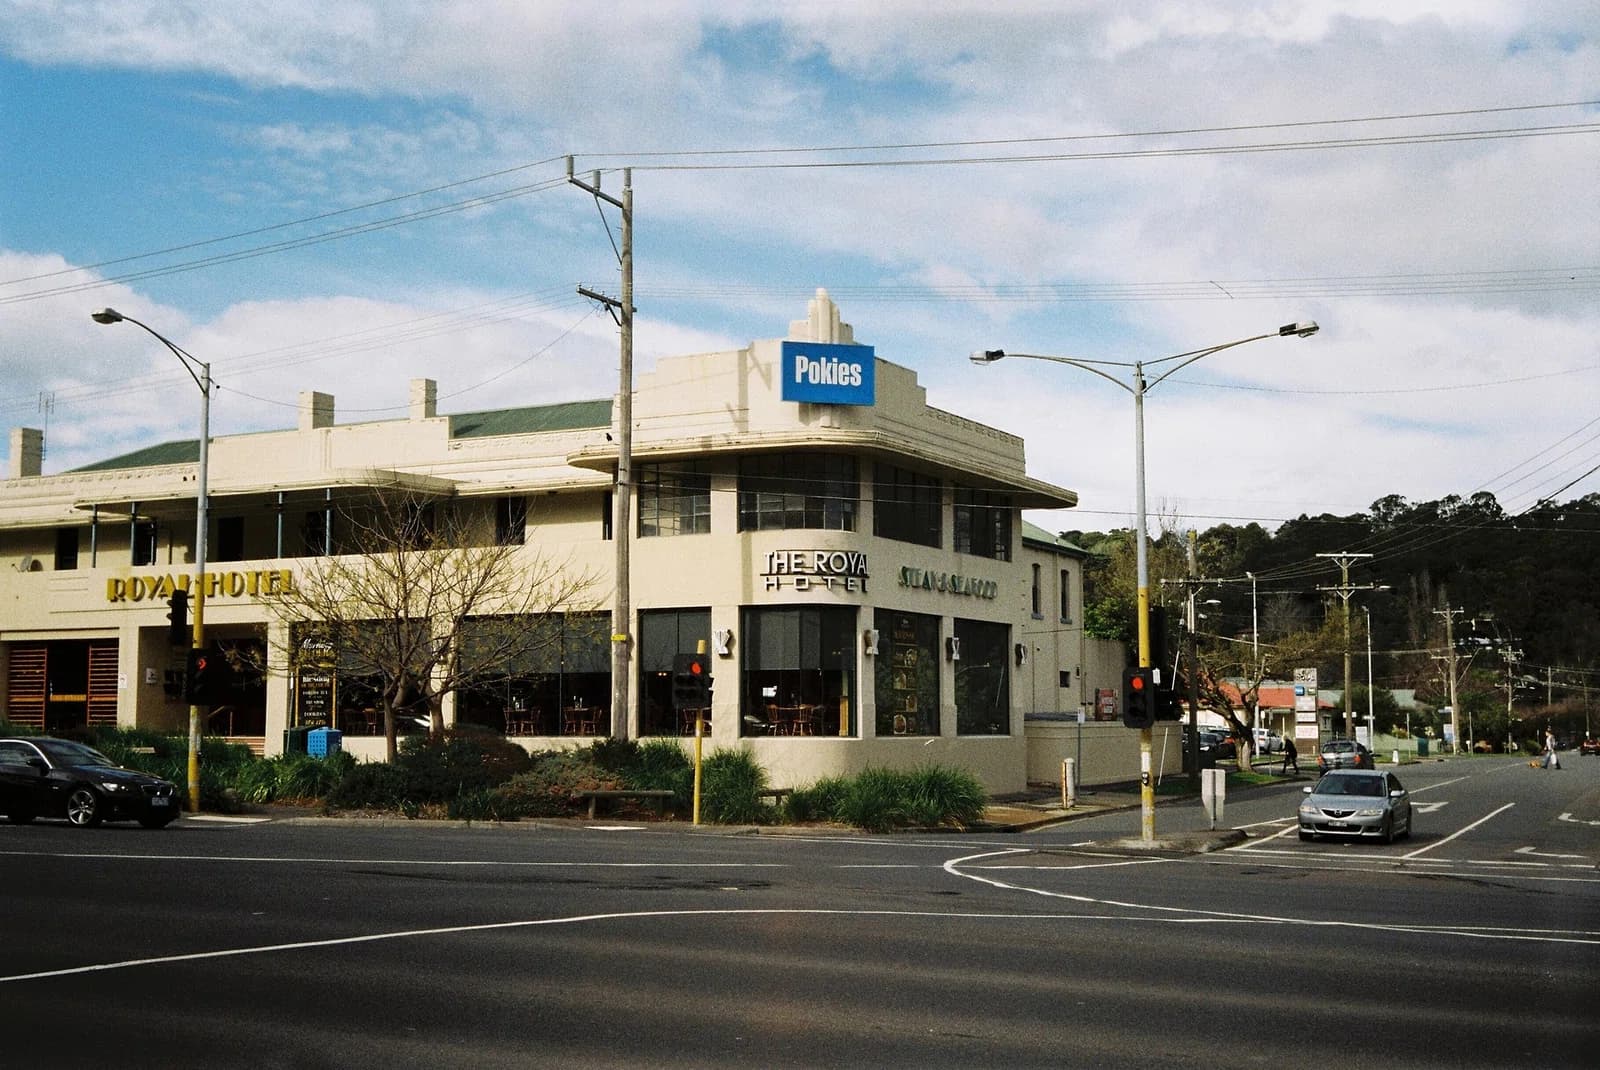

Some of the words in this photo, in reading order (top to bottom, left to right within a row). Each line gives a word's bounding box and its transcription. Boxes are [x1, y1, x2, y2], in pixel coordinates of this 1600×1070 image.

[795, 355, 862, 387] Pokies
[764, 551, 804, 574] THE
[107, 573, 195, 602] ROYAL
[203, 568, 294, 597] HOTEL
[765, 576, 868, 592] HOTEL
